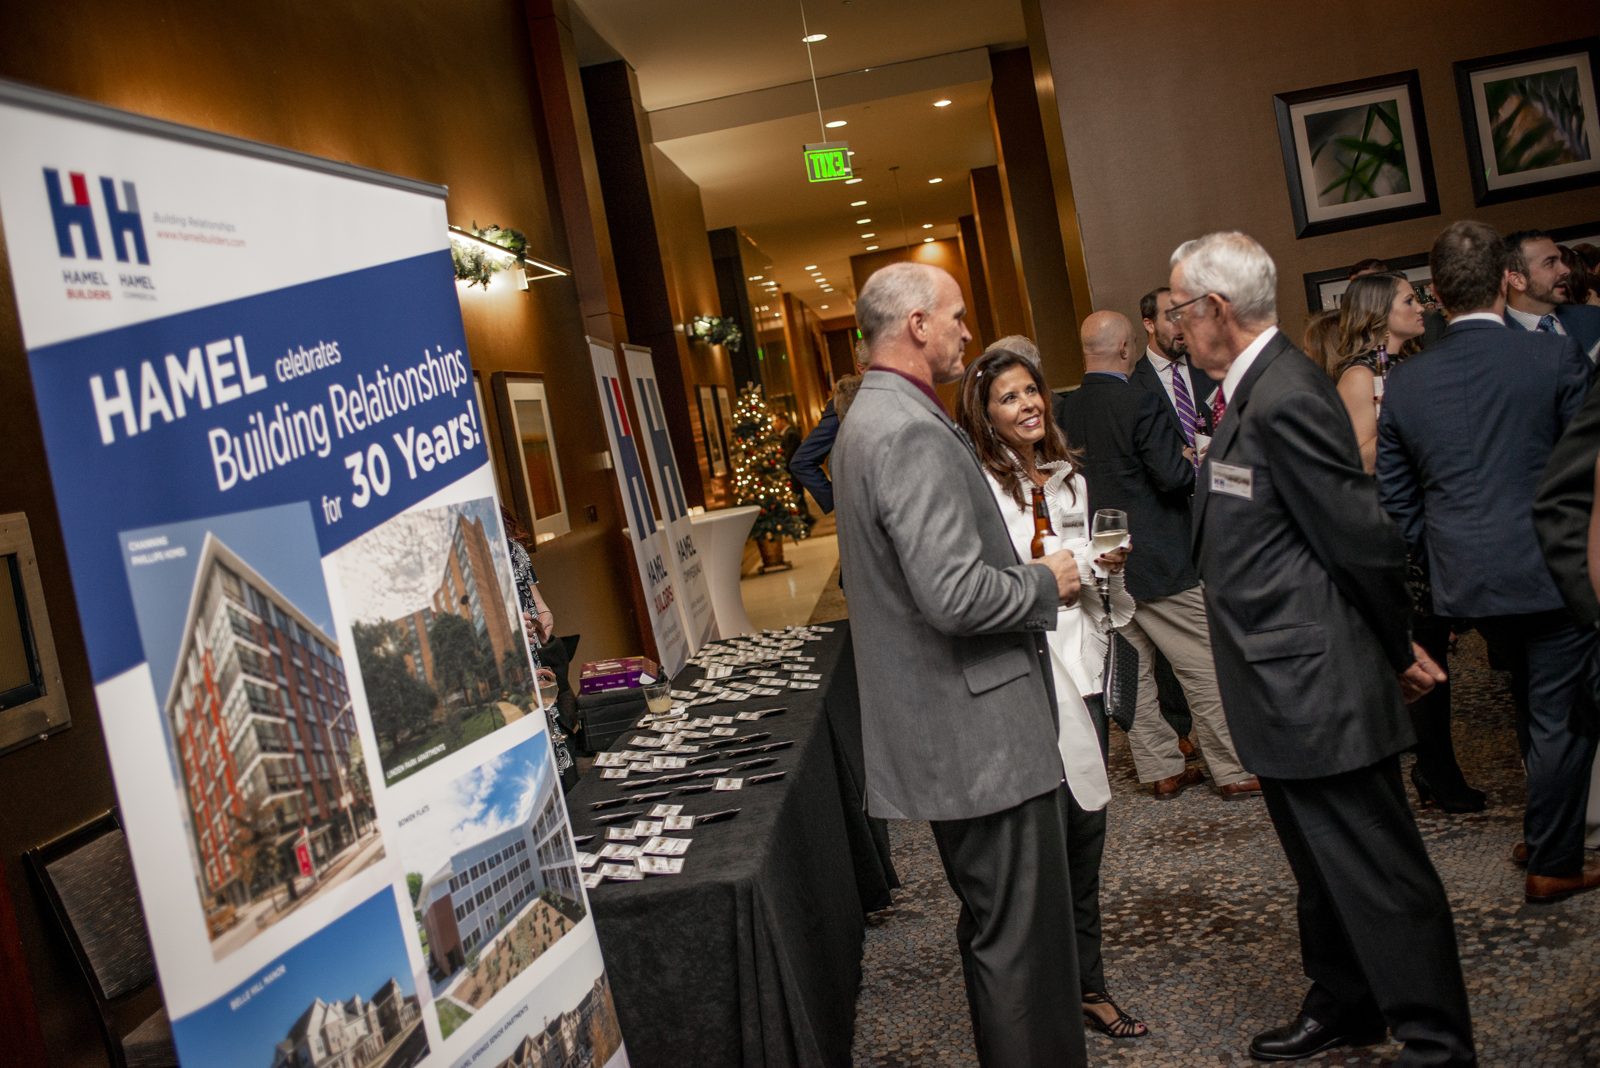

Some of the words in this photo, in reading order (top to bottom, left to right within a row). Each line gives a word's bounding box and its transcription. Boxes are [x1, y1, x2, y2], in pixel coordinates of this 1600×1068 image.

[62, 269, 109, 286] HAMEL
[66, 287, 112, 301] BUILDERS
[118, 273, 156, 290] HAMEL
[89, 334, 268, 446] HAMEL
[274, 340, 342, 383] celebrates
[207, 401, 332, 492] Building
[328, 345, 468, 439] Relationships
[321, 495, 343, 526] for
[344, 442, 391, 509] 30
[393, 399, 481, 481] Years!
